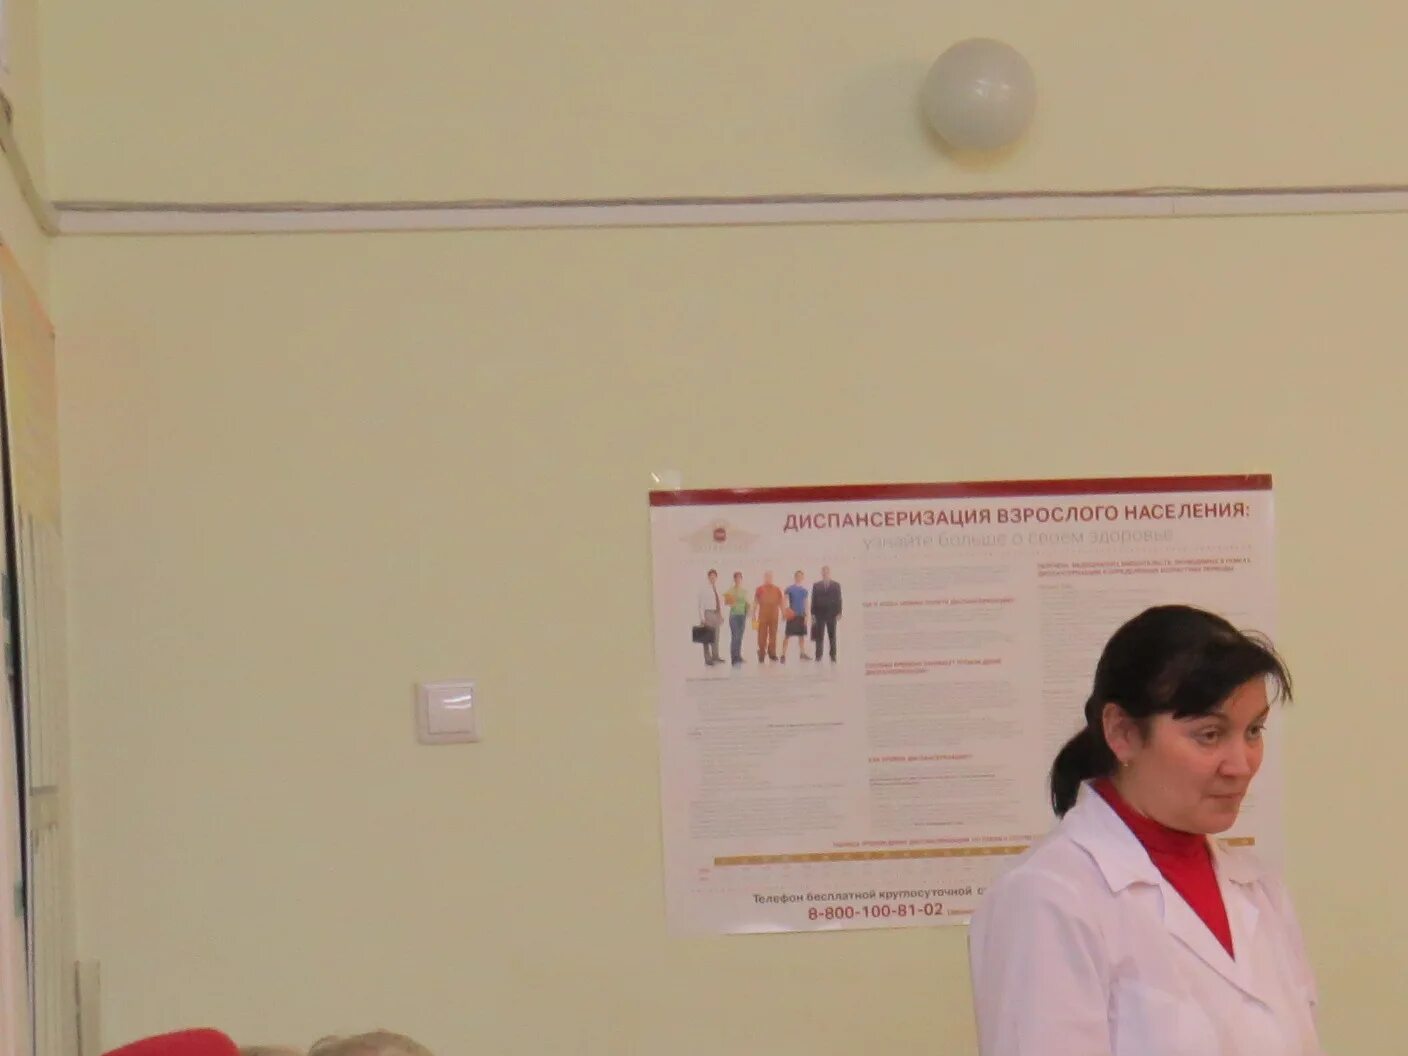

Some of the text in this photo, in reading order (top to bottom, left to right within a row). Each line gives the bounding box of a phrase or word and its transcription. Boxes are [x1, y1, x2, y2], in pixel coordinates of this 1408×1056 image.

[783, 502, 1250, 532] ДИСПАНСЕРИЗАЦИЯ ВЗРОСЛОГО НАСЕЛЕНИЯ:
[937, 530, 1008, 548] больше
[1012, 533, 1024, 545] о
[1090, 528, 1173, 546] здоровье
[753, 892, 804, 904] Телефон
[806, 889, 876, 902] бесплатной
[879, 885, 972, 900] круглосуточной
[808, 903, 943, 920] 8-800-100-81-02
